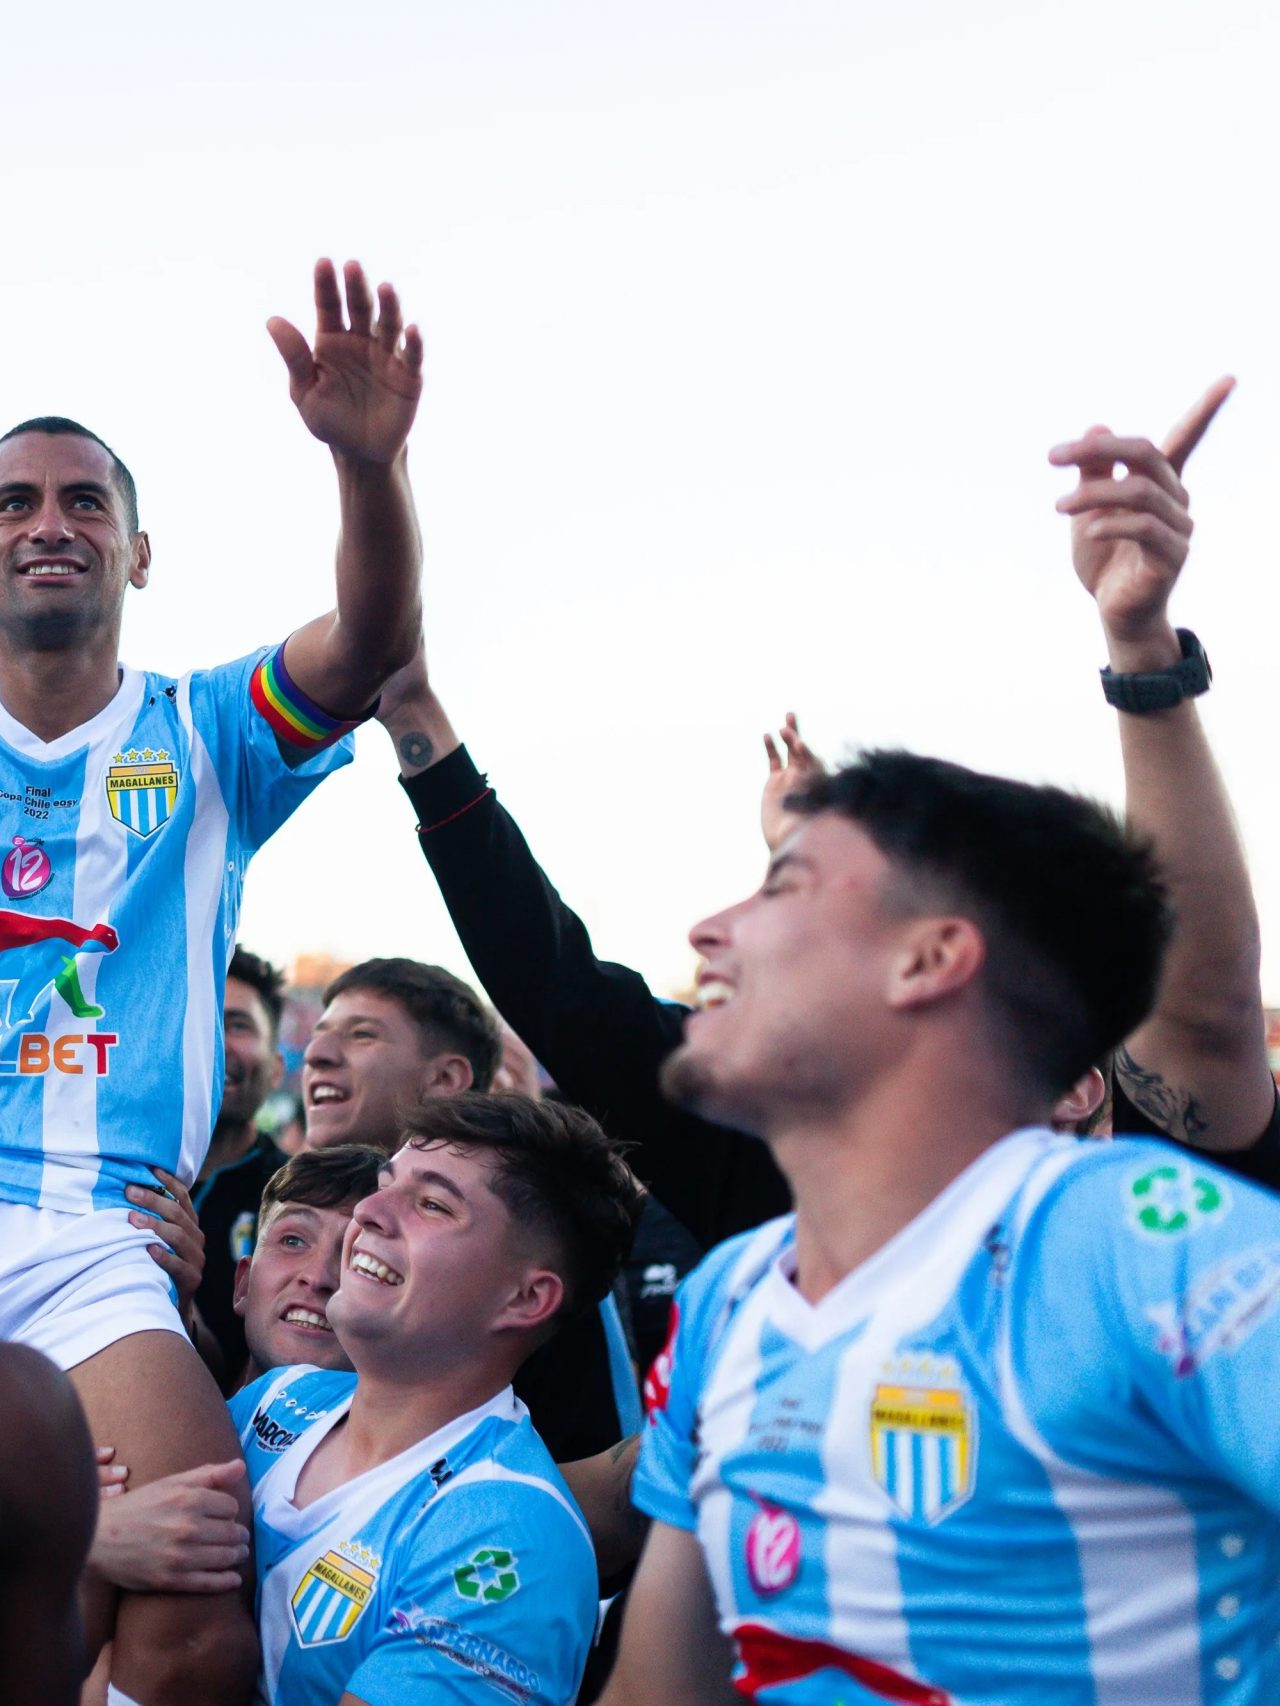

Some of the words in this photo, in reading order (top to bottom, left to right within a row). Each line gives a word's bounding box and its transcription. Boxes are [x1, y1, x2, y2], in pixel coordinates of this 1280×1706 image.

[110, 775, 174, 788] MAGALLANES
[25, 785, 51, 798] Final
[24, 796, 51, 809] Chile
[53, 799, 78, 809] easy
[23, 806, 49, 820] 2022
[9, 847, 44, 892] 12
[313, 1561, 367, 1601] MAGALLANES
